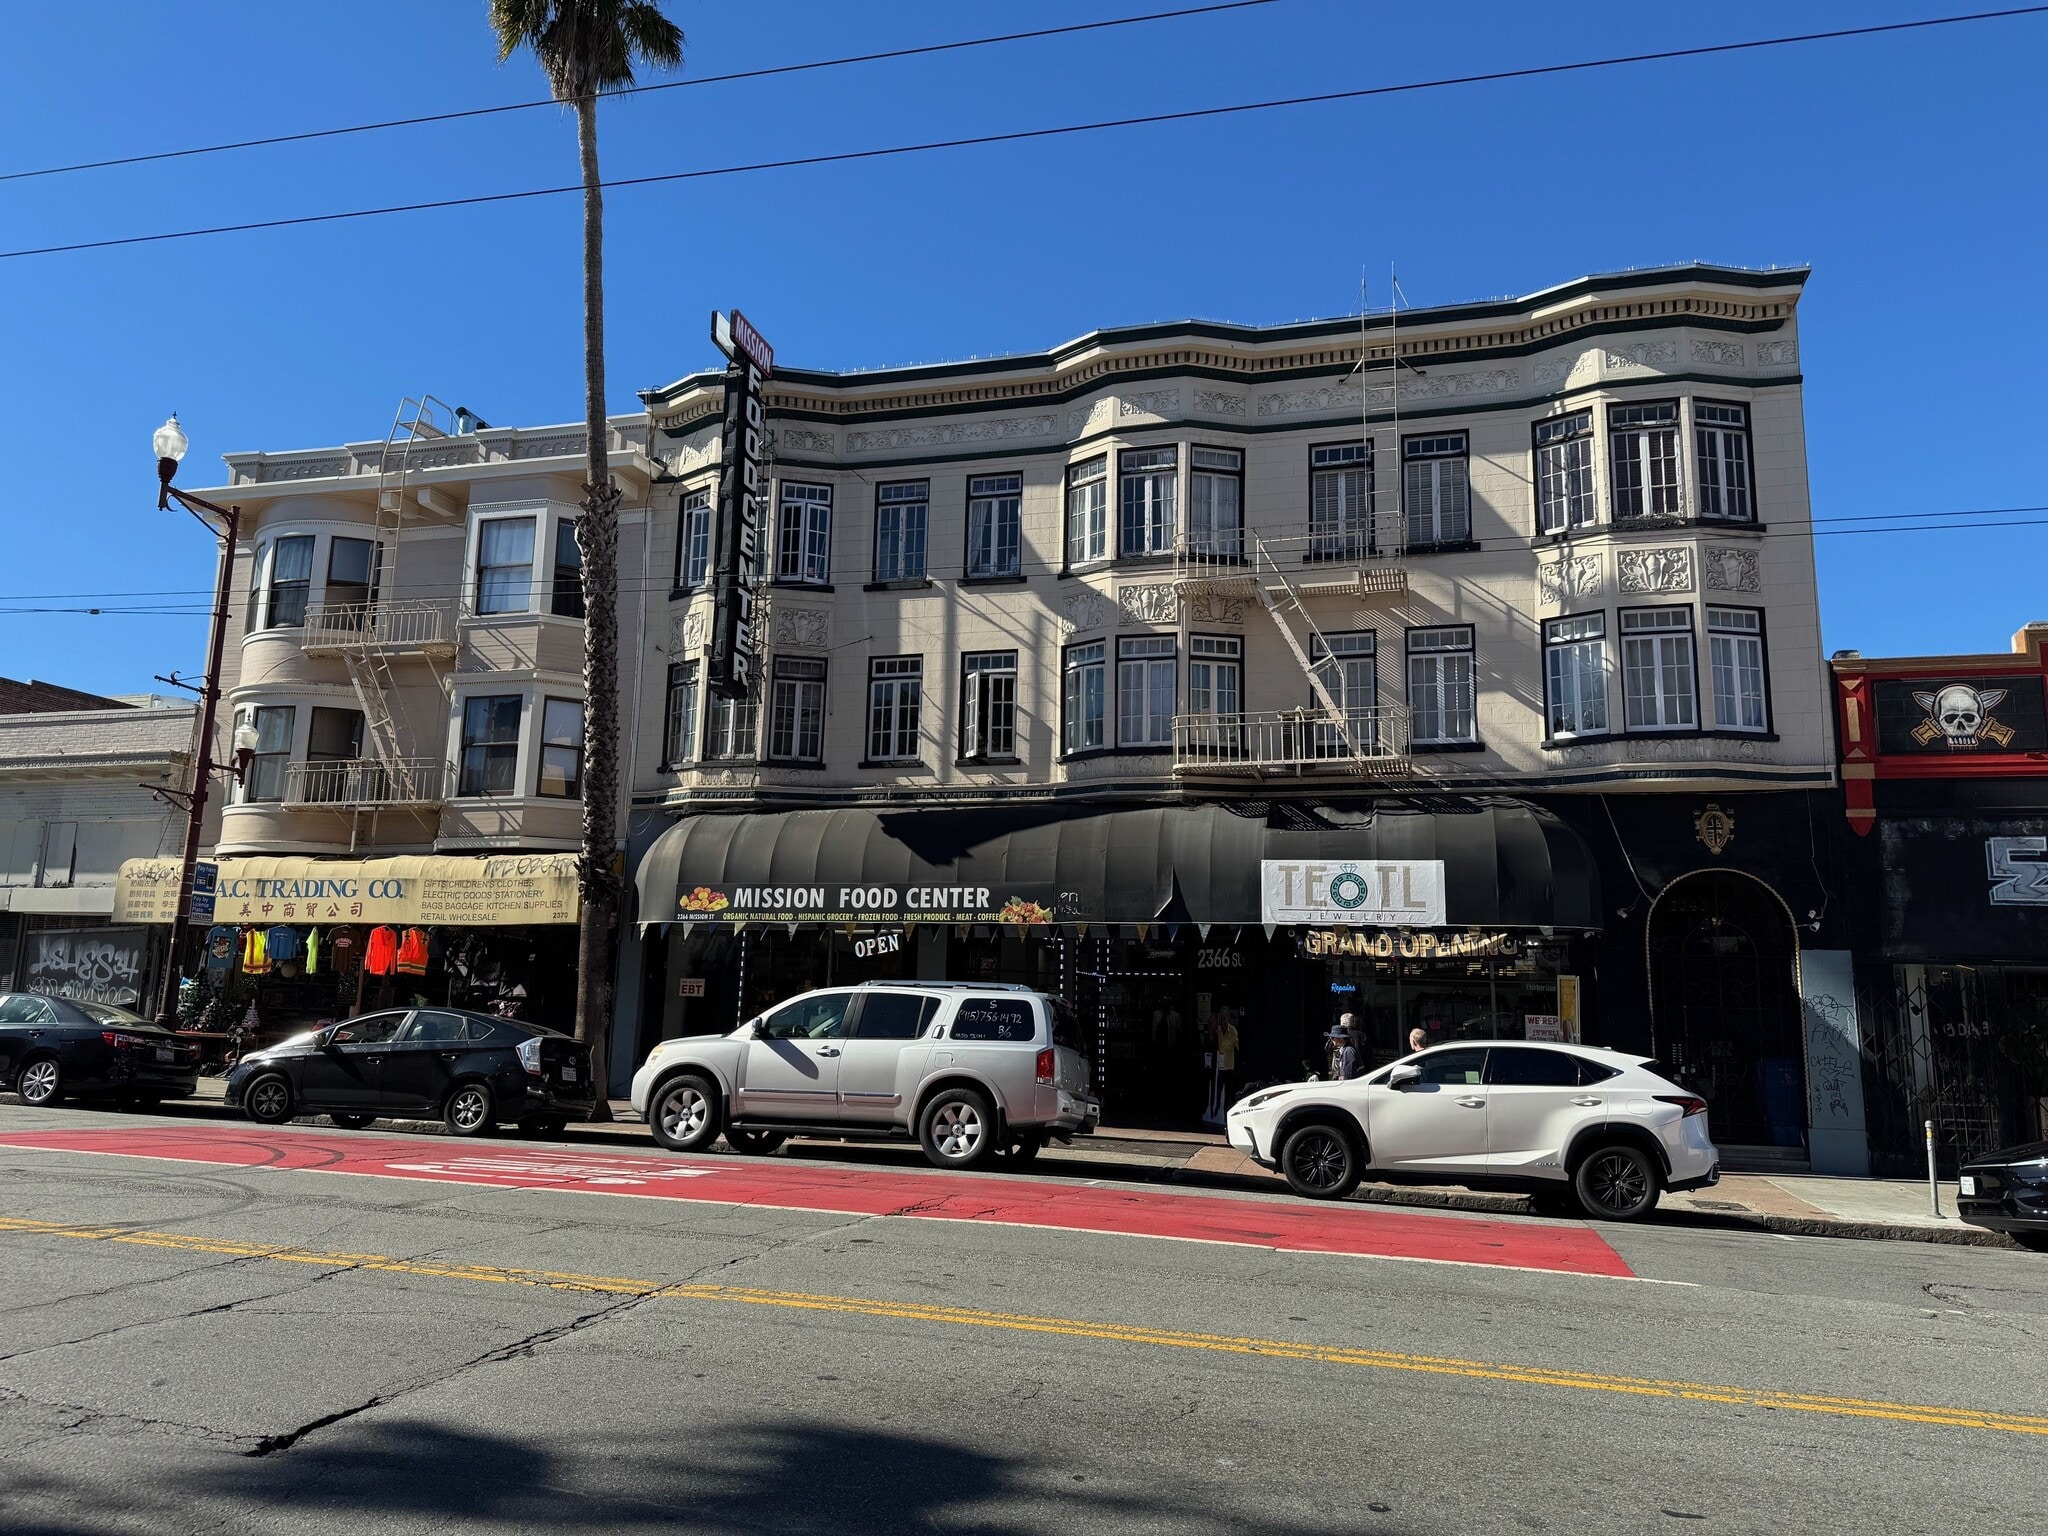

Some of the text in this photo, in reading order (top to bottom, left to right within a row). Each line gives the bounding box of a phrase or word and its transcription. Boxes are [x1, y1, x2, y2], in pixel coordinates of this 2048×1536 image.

[735, 315, 772, 374] MISSION
[733, 363, 762, 687] FOOD CENTER
[257, 879, 359, 898] TRADING
[368, 879, 404, 899] CO.
[424, 879, 534, 888] GIFTS CHILDREN'S CLOTHES
[422, 889, 544, 899] ELECTRIC GOODS STATIONERY
[733, 887, 990, 909] MISSION FOOD CENTER
[239, 901, 363, 918] 美中商貿公司
[421, 900, 563, 910] BAGS BAGGAGE KITCHEN SUPPLIES
[420, 912, 497, 921] RETAIL WHOLESALE
[552, 911, 568, 919] 2370
[722, 912, 1000, 921] ORGANIC NATURAL FOOD HISPANIC GROCERY FROZEN FOOD FRESH PRODUCE MEAT COFFEE
[1307, 912, 1396, 921] JEWELRY
[854, 933, 899, 958] OPEN
[1304, 930, 1518, 958] GRAND OPENING
[1197, 947, 1230, 969] 2366
[681, 984, 703, 995] EBT
[1331, 982, 1356, 994] Repairs
[1527, 1016, 1558, 1025] WE REP
